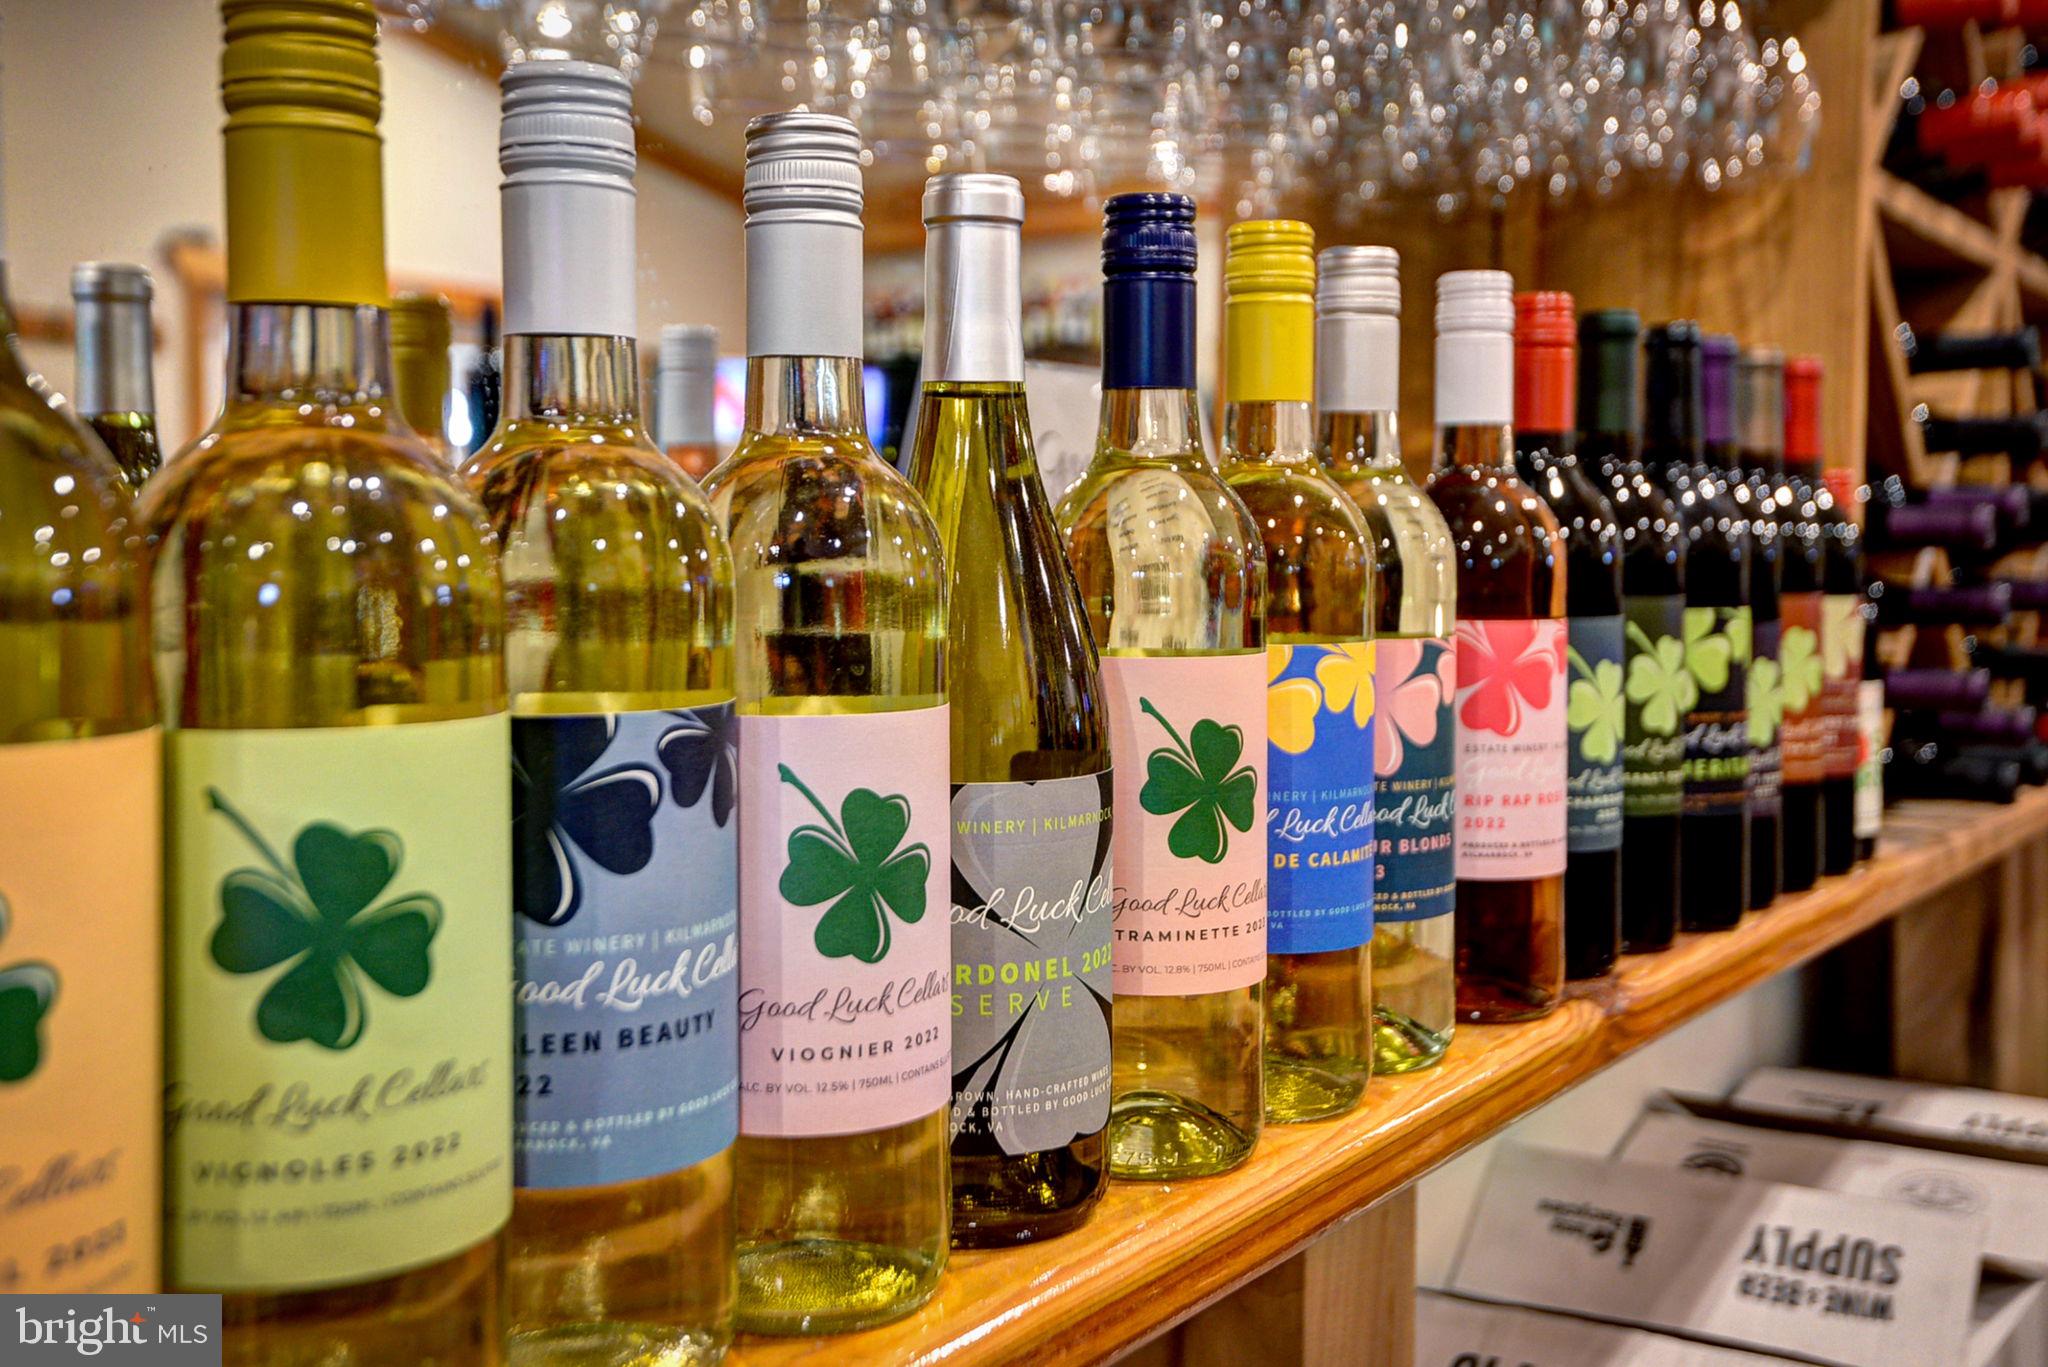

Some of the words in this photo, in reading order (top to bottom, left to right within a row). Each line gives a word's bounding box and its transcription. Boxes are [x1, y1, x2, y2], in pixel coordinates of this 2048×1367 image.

[1464, 743, 1508, 753] ESTATE
[1392, 779, 1432, 793] WINERY
[1464, 793, 1494, 806] RIP
[1502, 793, 1532, 806] RAP
[956, 820, 1026, 835] WINERY
[1274, 805, 1339, 842] Luck
[1463, 816, 1505, 830] 2022
[1273, 853, 1300, 868] DE
[1000, 879, 1084, 934] Luck
[1112, 887, 1179, 923] Good
[1175, 884, 1231, 918] Luck
[1115, 924, 1240, 943] TRAMINETTE
[1270, 921, 1284, 929] VA
[565, 932, 647, 955] WINERY
[594, 949, 693, 1012] Luck
[955, 956, 1073, 986] RDONEL
[1122, 964, 1137, 974] BY
[1164, 963, 1191, 975] 12.8%
[1198, 962, 1227, 974] 750ML
[738, 987, 829, 1033] Good
[824, 980, 896, 1024] Luck
[951, 985, 1073, 1017] SERVE
[518, 1029, 602, 1057] LEEN
[617, 1008, 717, 1050] BEAUTY
[771, 1039, 894, 1063] VIOGNIER
[904, 1026, 940, 1051] 2022
[766, 1083, 784, 1094] BY
[858, 1075, 894, 1090] 750ML
[1006, 1075, 1090, 1100] HAND-CRAFTED
[1091, 1064, 1109, 1083] WINES
[968, 1106, 976, 1118] &
[982, 1103, 1041, 1118] BOTTLED
[1045, 1099, 1059, 1111] BY
[1062, 1091, 1089, 1108] GOOD
[987, 1120, 1004, 1133] VA
[194, 1150, 376, 1186] VIGNOLES
[1743, 1224, 1905, 1286] SUPPLY
[1738, 1271, 1803, 1307] BEER
[1825, 1284, 1895, 1320] WINE
